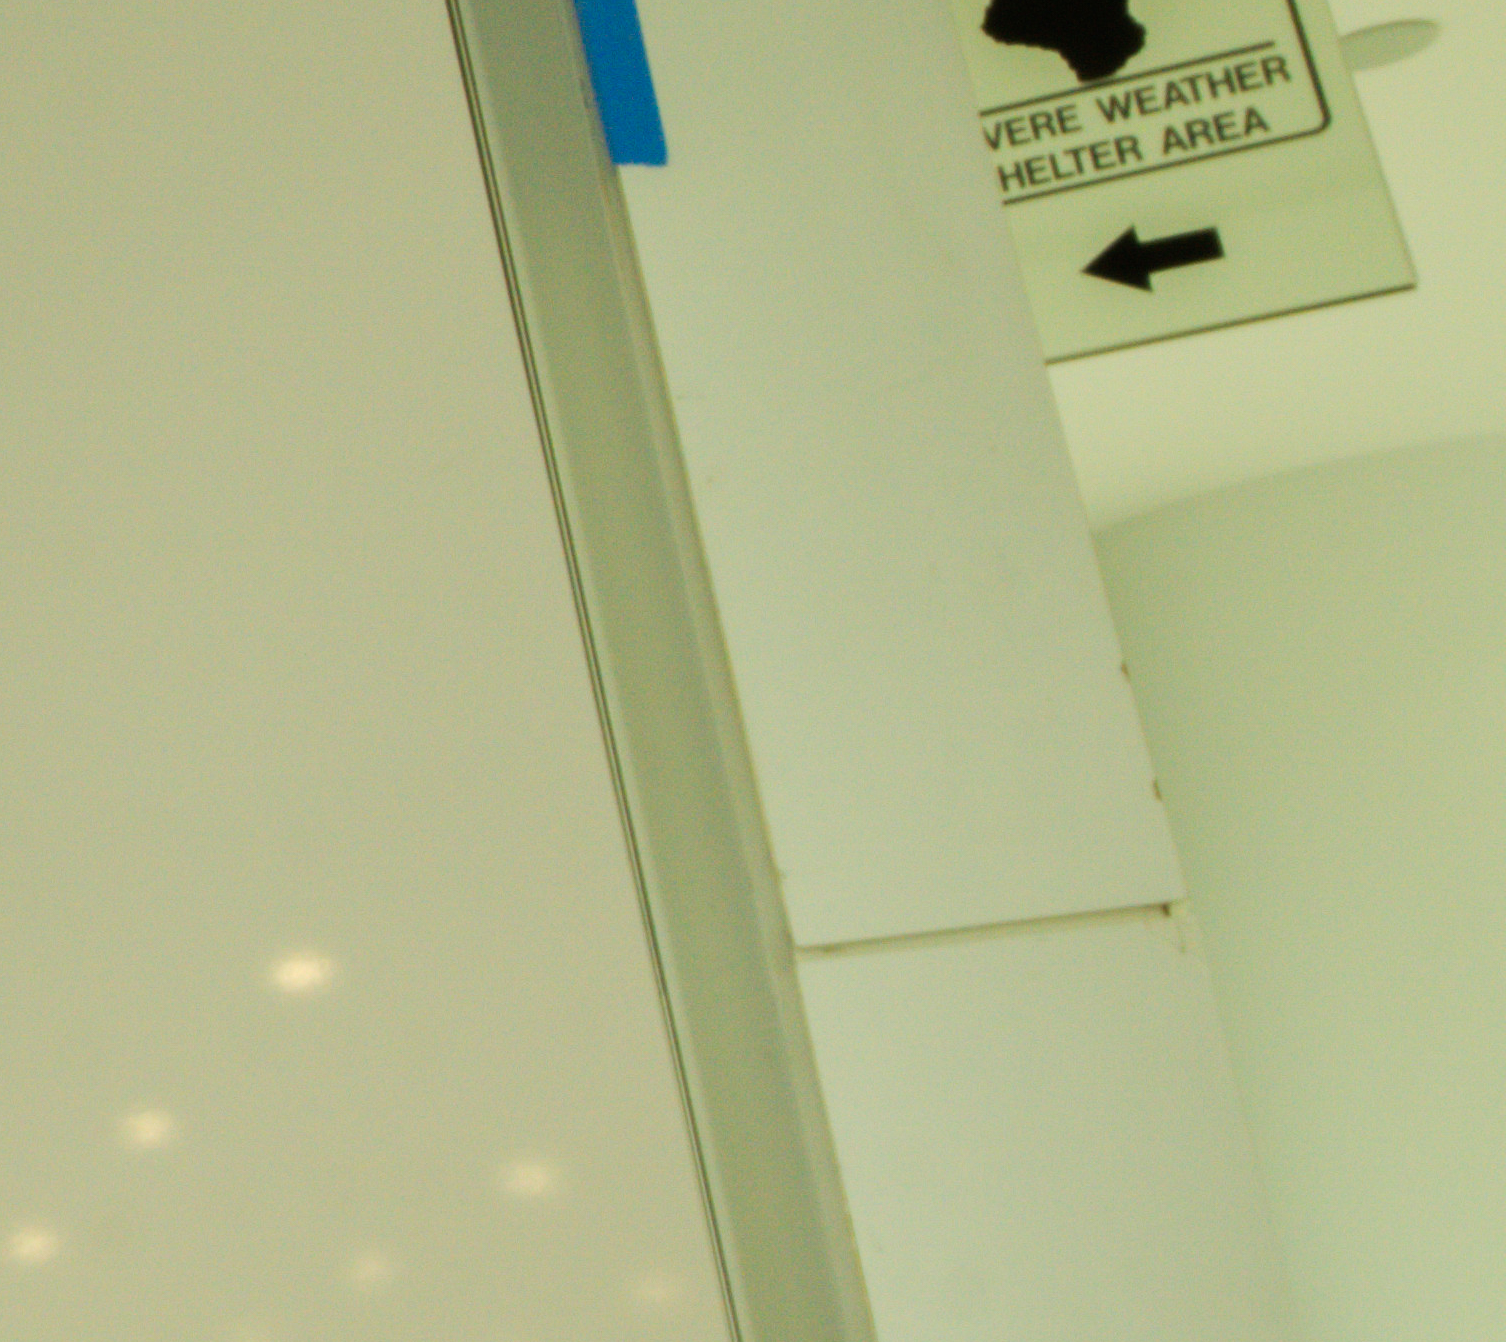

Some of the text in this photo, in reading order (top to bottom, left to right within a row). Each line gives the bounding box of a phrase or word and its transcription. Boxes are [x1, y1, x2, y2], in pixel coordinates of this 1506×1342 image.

[984, 57, 1290, 151] VERE WEATHER
[998, 107, 1270, 192] HELTER AREA
